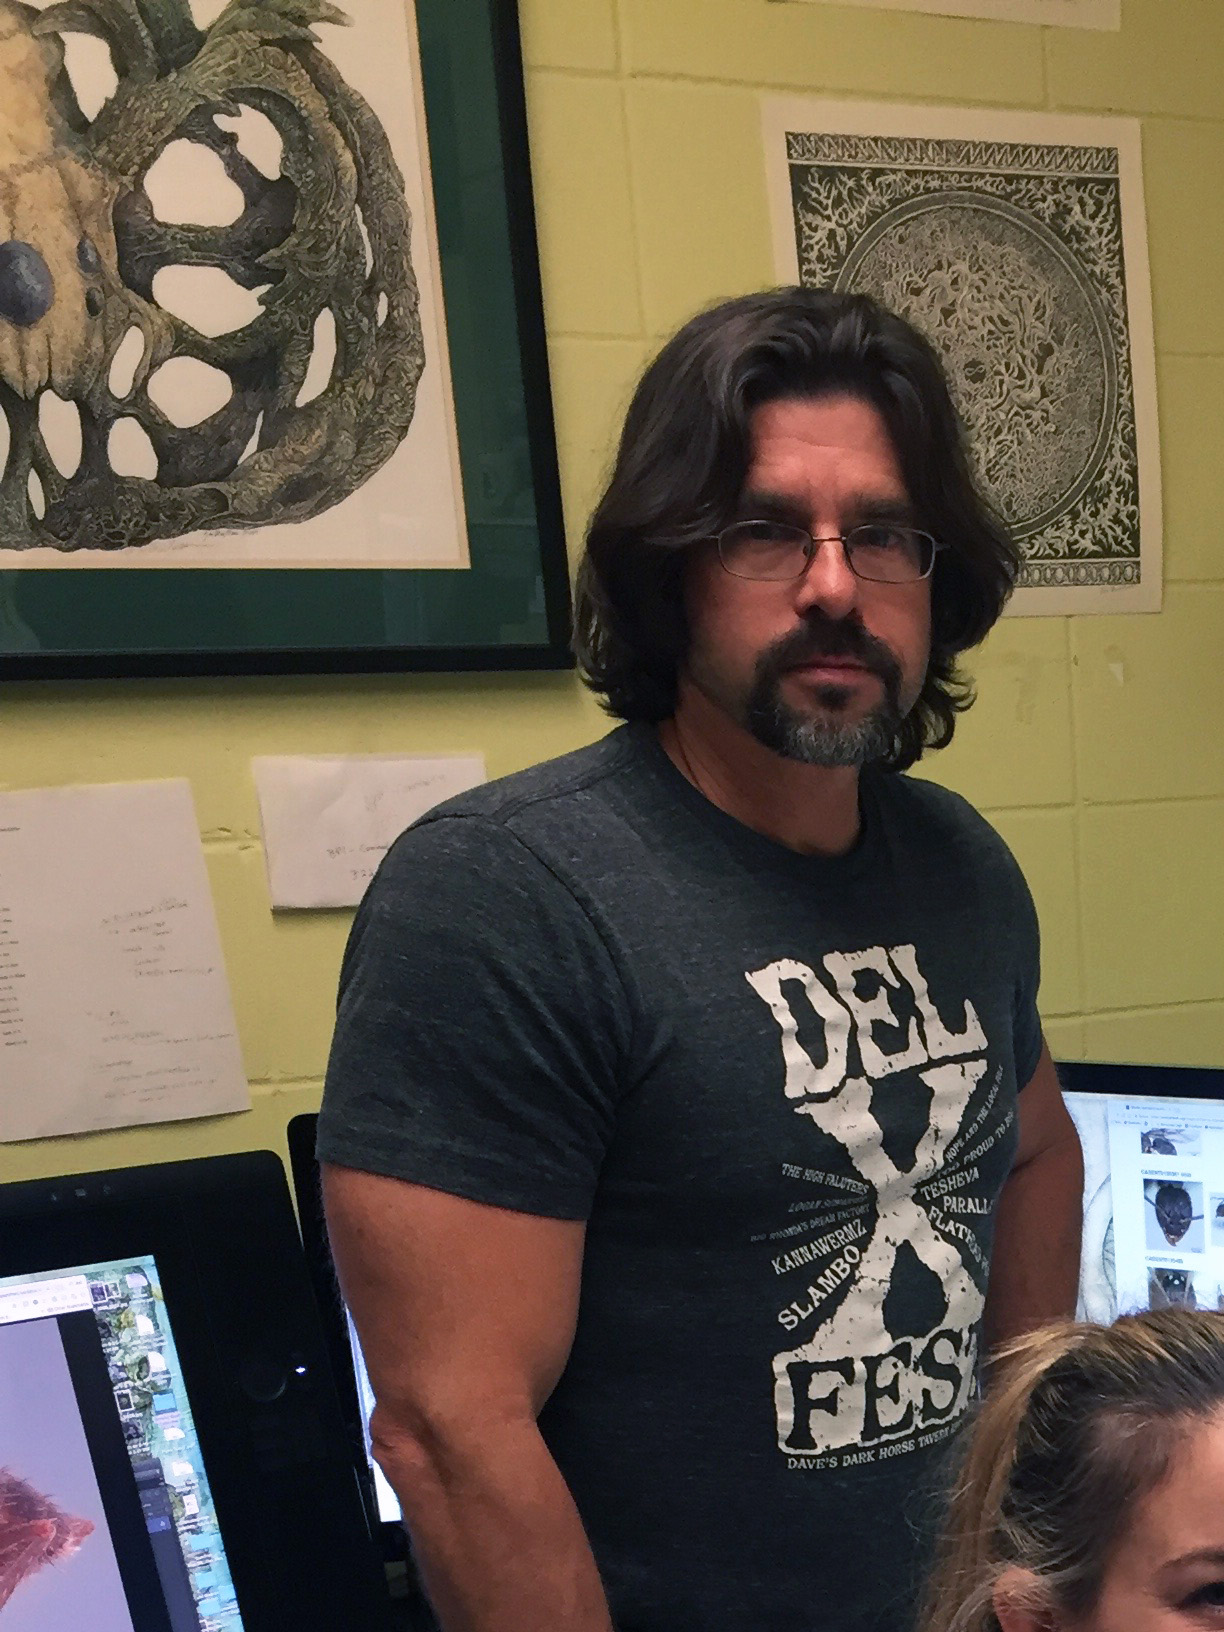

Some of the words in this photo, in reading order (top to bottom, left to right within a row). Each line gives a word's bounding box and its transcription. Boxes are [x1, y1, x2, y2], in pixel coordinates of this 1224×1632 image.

[745, 944, 988, 1099] DEL
[945, 1138, 965, 1162] HOPE
[976, 1105, 989, 1124] THE
[963, 1135, 995, 1165] PROUD
[781, 1163, 803, 1179] THE
[920, 1166, 980, 1201] TESHEVA
[771, 1218, 868, 1275] KANNAWERMZ
[778, 1244, 861, 1332] SLAMBO
[772, 1328, 978, 1456] FES
[787, 1456, 838, 1470] DAVE'S
[842, 1449, 876, 1468] DARK
[878, 1440, 916, 1460] HORSE
